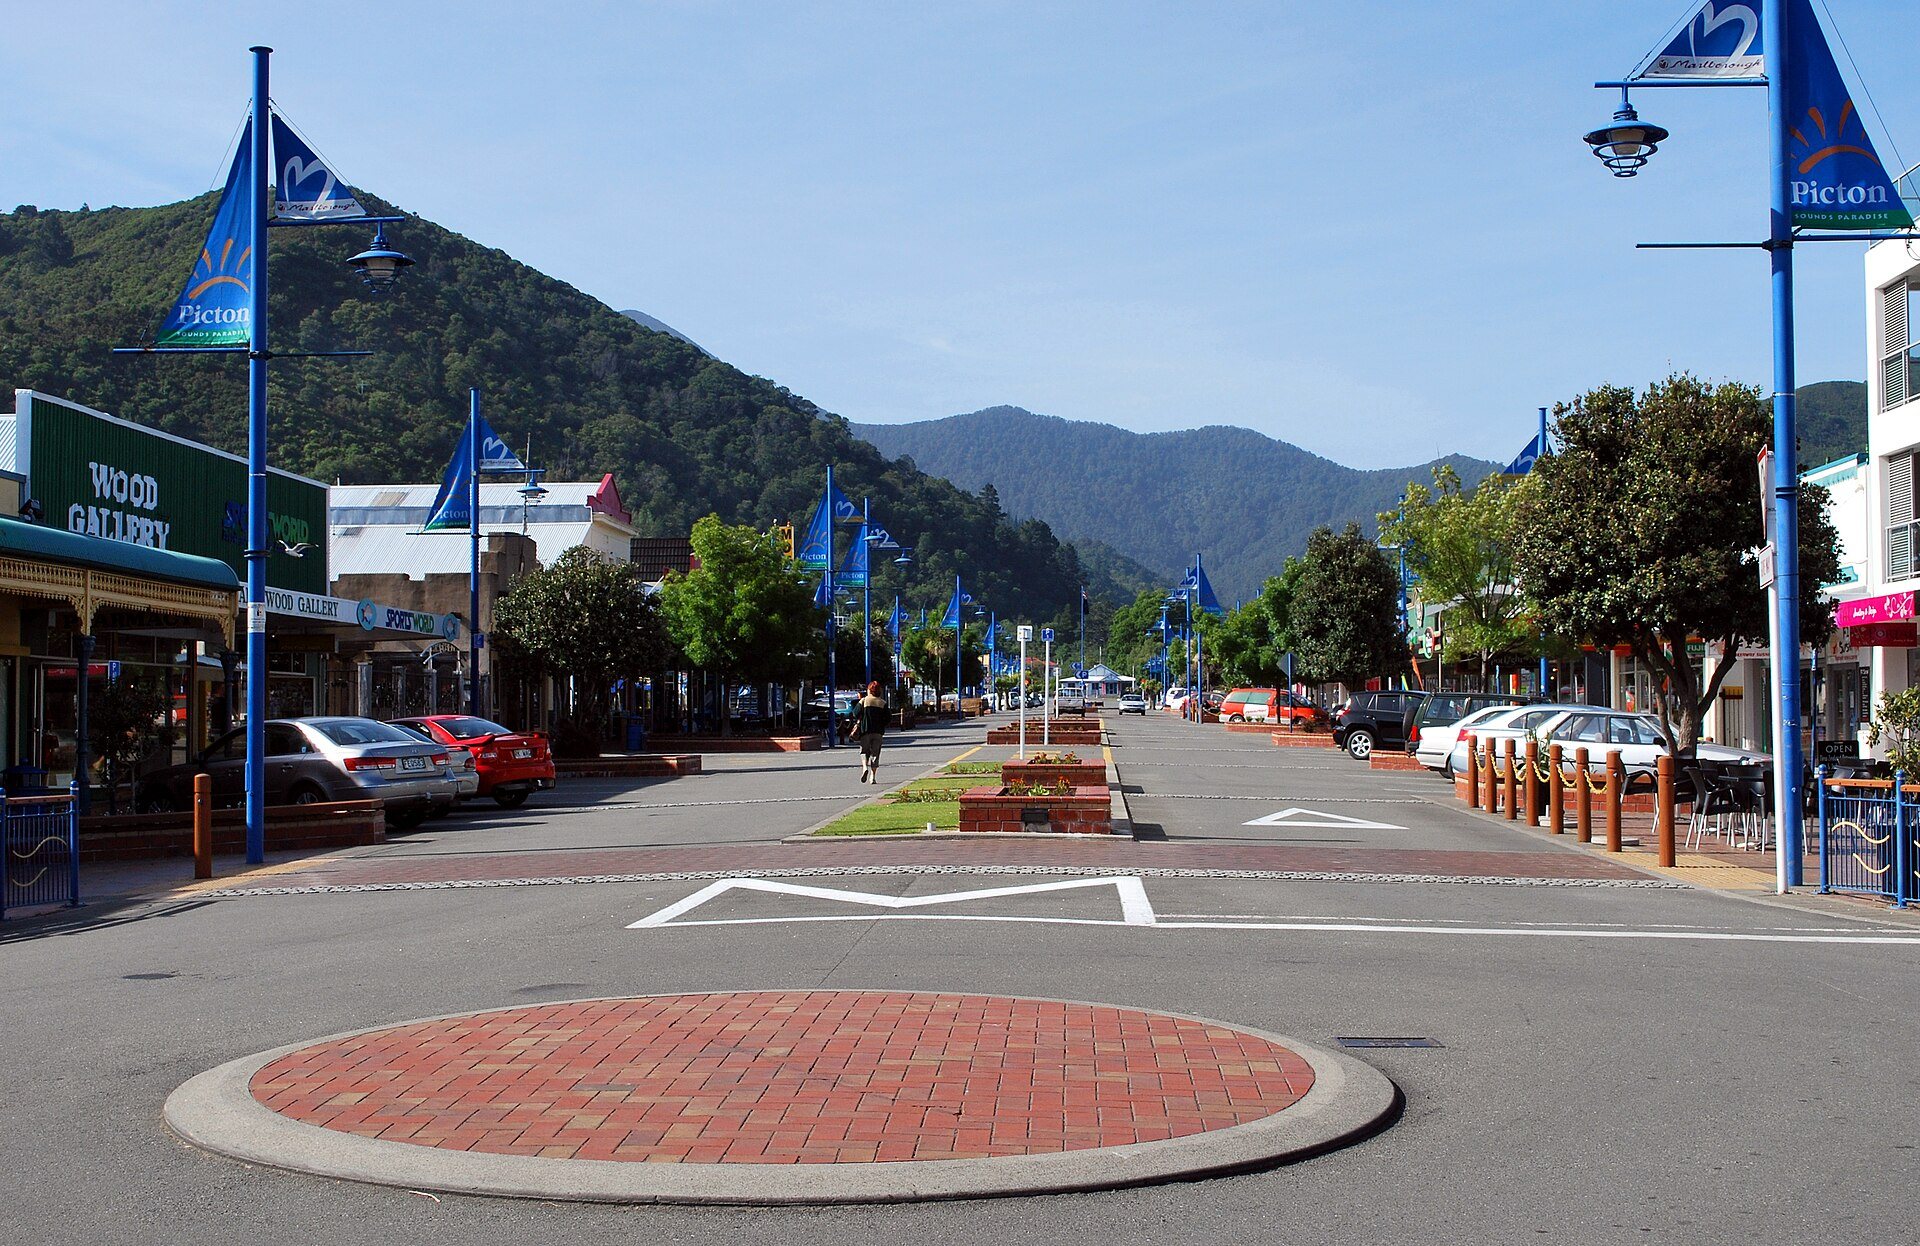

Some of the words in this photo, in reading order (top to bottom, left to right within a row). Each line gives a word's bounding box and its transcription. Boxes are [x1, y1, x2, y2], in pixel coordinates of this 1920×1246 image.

[1670, 58, 1762, 70] Marlborough
[1791, 181, 1889, 205] Picton
[289, 201, 356, 213] Marlborough
[1794, 212, 1834, 220] SOUNDS
[1837, 212, 1889, 220] PARADISE
[177, 304, 250, 324] Picton
[88, 461, 158, 510] WOOD
[67, 502, 170, 550] GALLERY
[800, 552, 827, 560] Picton
[841, 571, 864, 579] Picton
[266, 590, 294, 612] WOOD
[298, 597, 339, 618] GALLERY
[1687, 644, 1704, 652] FUJI
[1825, 744, 1853, 754] OPEN
